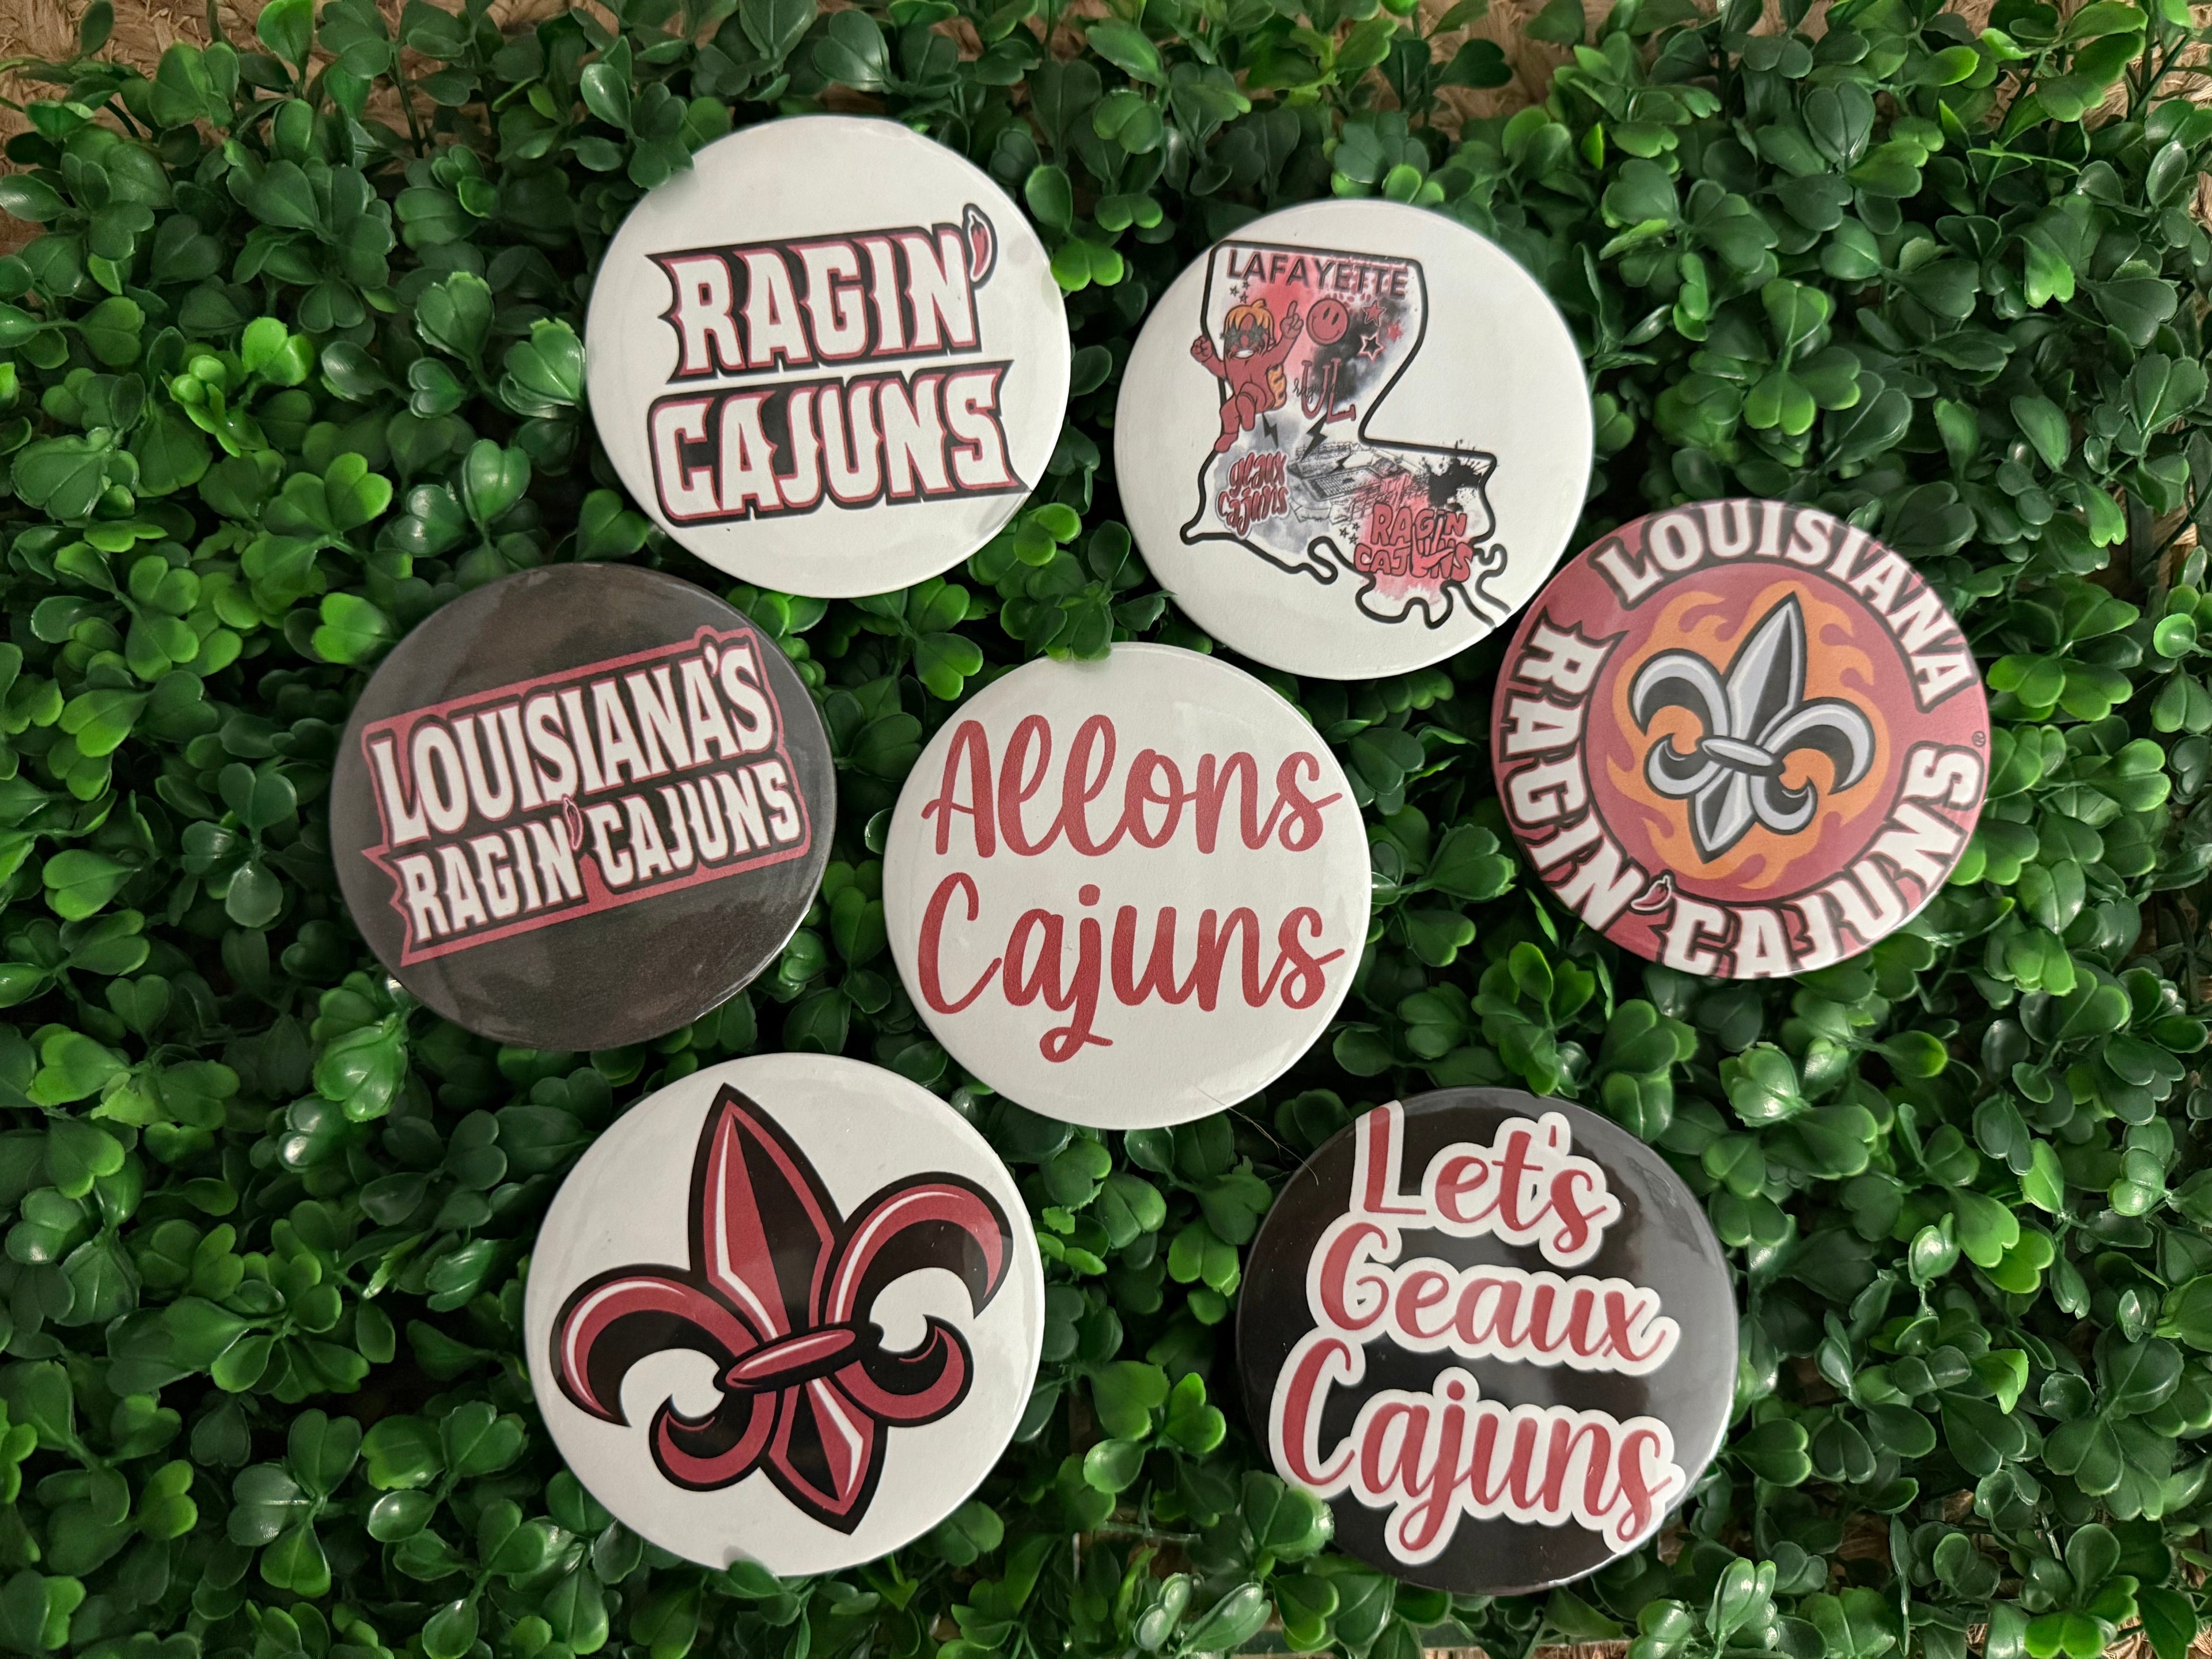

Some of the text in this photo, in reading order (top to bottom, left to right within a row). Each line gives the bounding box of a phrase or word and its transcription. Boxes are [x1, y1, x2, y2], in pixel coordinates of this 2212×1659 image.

[1227, 249, 1409, 300] LAFAYETTE
[650, 368, 1022, 521] CAJUNS
[1301, 358, 1357, 424] UL
[1594, 498, 1976, 707] LOUISIANA
[369, 641, 774, 847] LOUISIANA'S
[921, 714, 1343, 858] Allons
[581, 759, 802, 889] CAJUNS
[1661, 747, 1984, 979] CAJUNS
[918, 872, 1346, 1063] Cajuns
[1363, 1106, 1608, 1253] Let's
[1320, 1222, 1666, 1362] Geaux
[1282, 1337, 1673, 1552] Cajuns
